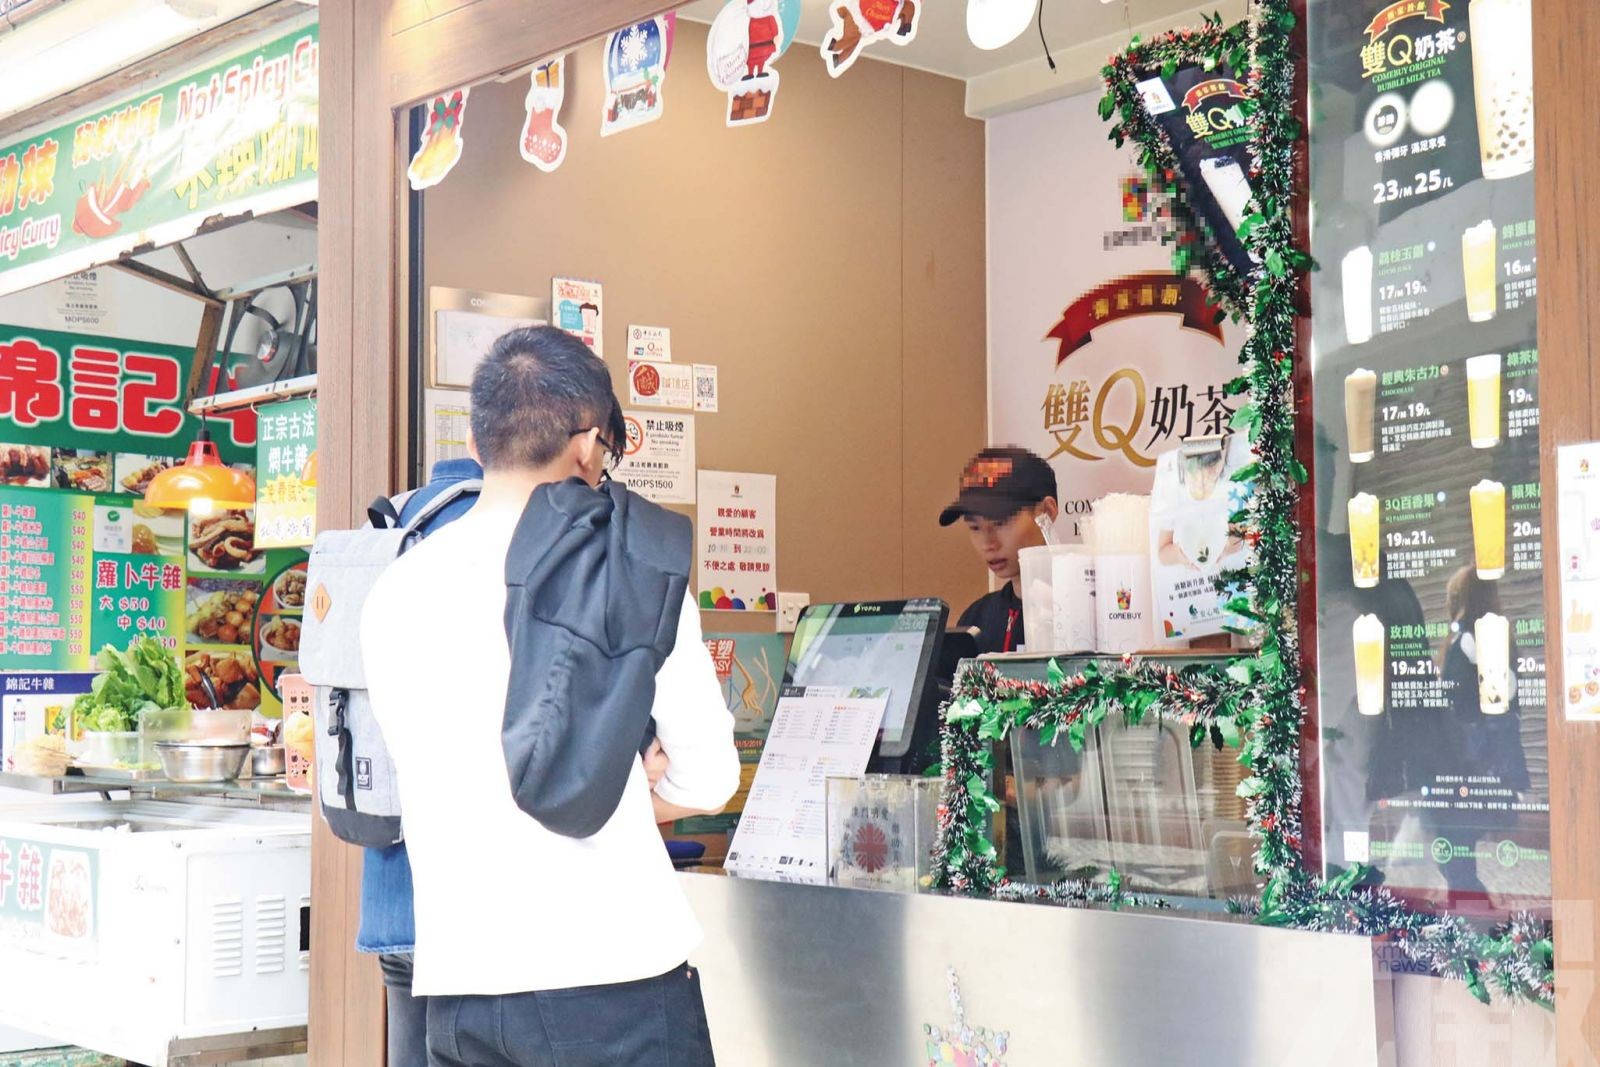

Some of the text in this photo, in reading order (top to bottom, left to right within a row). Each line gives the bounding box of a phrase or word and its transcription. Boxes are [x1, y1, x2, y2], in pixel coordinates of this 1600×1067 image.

[1360, 28, 1455, 78] 雙Q奶茶
[1372, 55, 1446, 84] COMEBUY ORIGINAL
[1377, 67, 1441, 93] BUBBLE MILK TEA
[1373, 169, 1453, 204] 23/M 25/L
[21, 213, 60, 249] Curry
[1504, 260, 1531, 277] 16/M
[1379, 283, 1403, 301] 17/M
[1381, 365, 1440, 387] 經典朱古力
[1508, 388, 1533, 404] 19/L
[1041, 368, 1237, 468] 雙Q奶茶
[1382, 402, 1431, 421] 17/M 19/L
[262, 410, 315, 441] 正宗古法
[646, 419, 684, 432] 禁止吸煙
[628, 479, 673, 489] MOPS1500
[1384, 493, 1436, 512] 3Q百香果
[1512, 502, 1536, 511] CRYSTAL
[717, 507, 757, 519] 親愛的顧客
[1513, 522, 1540, 537] 20/M
[1386, 530, 1435, 547] 19/M 21/L
[733, 543, 741, 554] 到
[704, 560, 770, 573] 不便之處 敬請見諒
[96, 560, 182, 590] 蘿卜牛雜
[99, 597, 149, 611] 大 $50
[118, 616, 166, 630] 中 $40
[1109, 612, 1141, 620] COMEBUY
[1516, 618, 1544, 634] 仙草
[1391, 660, 1440, 676] 19/M 21/L
[1517, 658, 1545, 672] 20/M
[5, 677, 55, 691] 錦記牛雜
